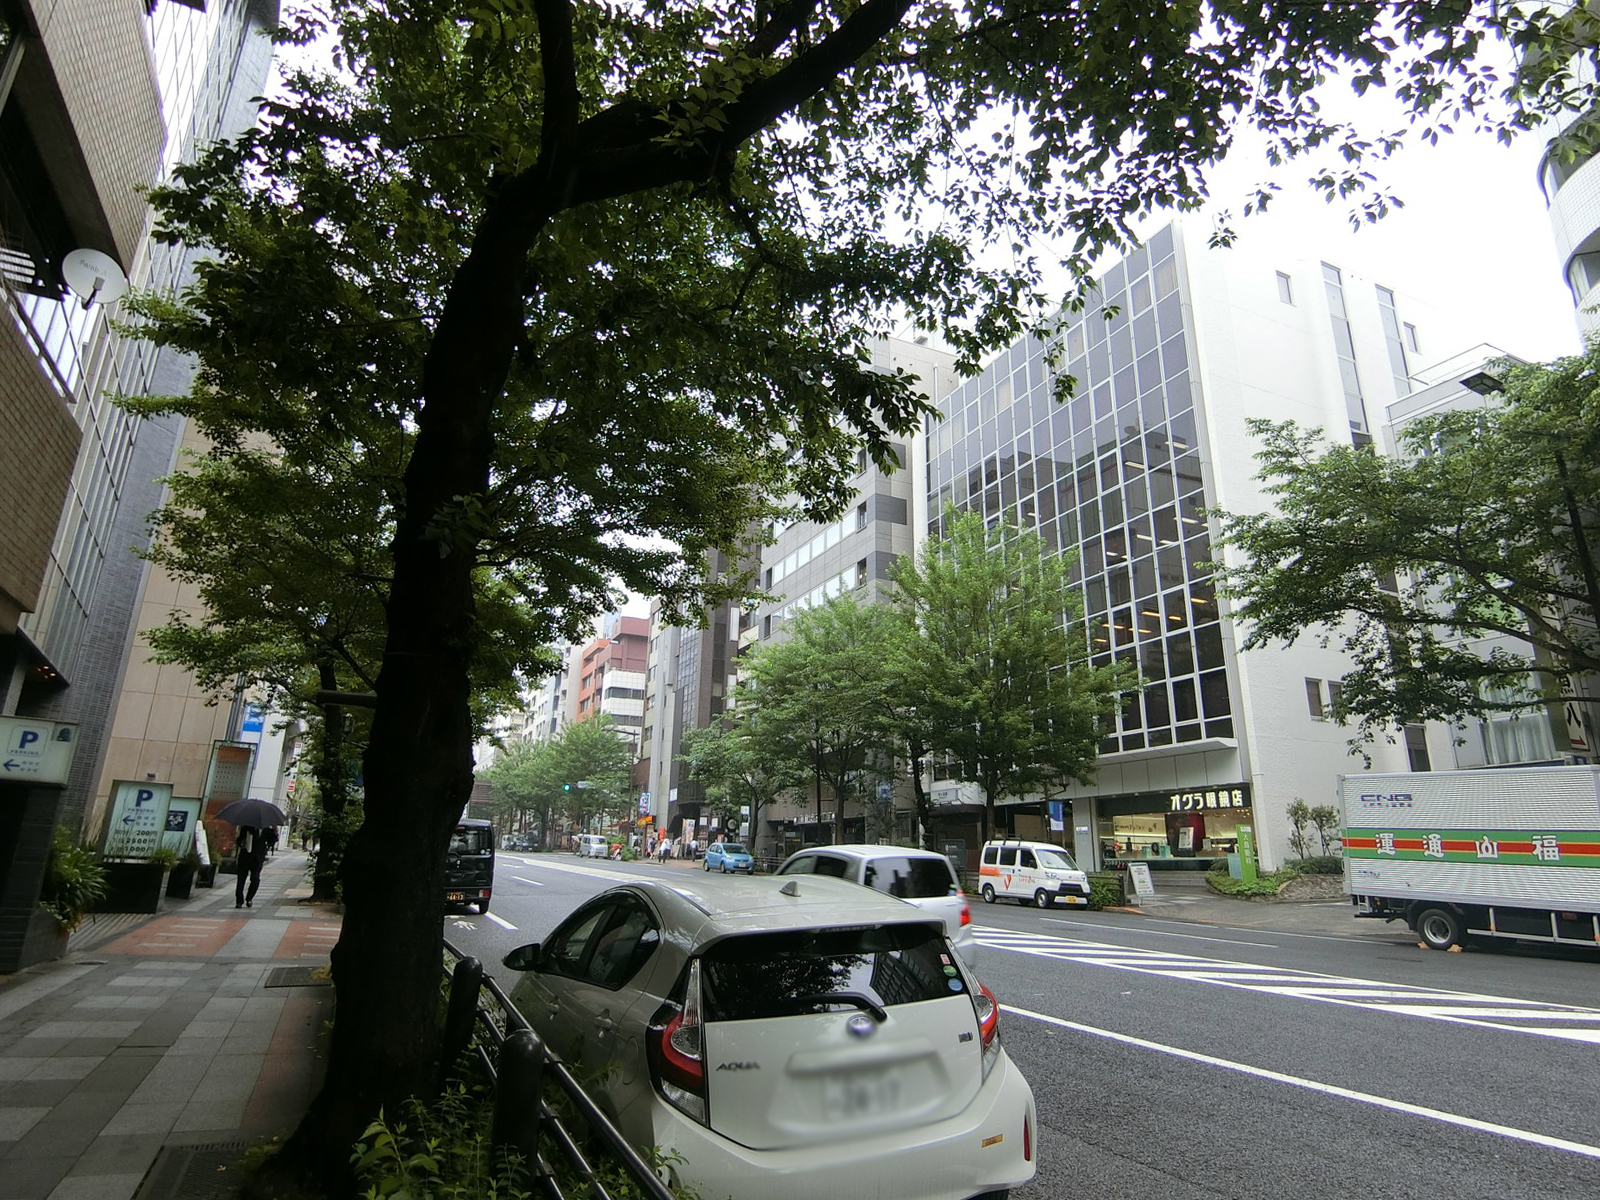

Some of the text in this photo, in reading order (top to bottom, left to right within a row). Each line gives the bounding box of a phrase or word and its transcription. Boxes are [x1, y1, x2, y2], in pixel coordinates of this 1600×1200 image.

[19, 730, 39, 749] P
[135, 789, 153, 807] P
[1170, 789, 1244, 811] オグラ眼鏡店
[716, 1061, 761, 1073] AQUA
